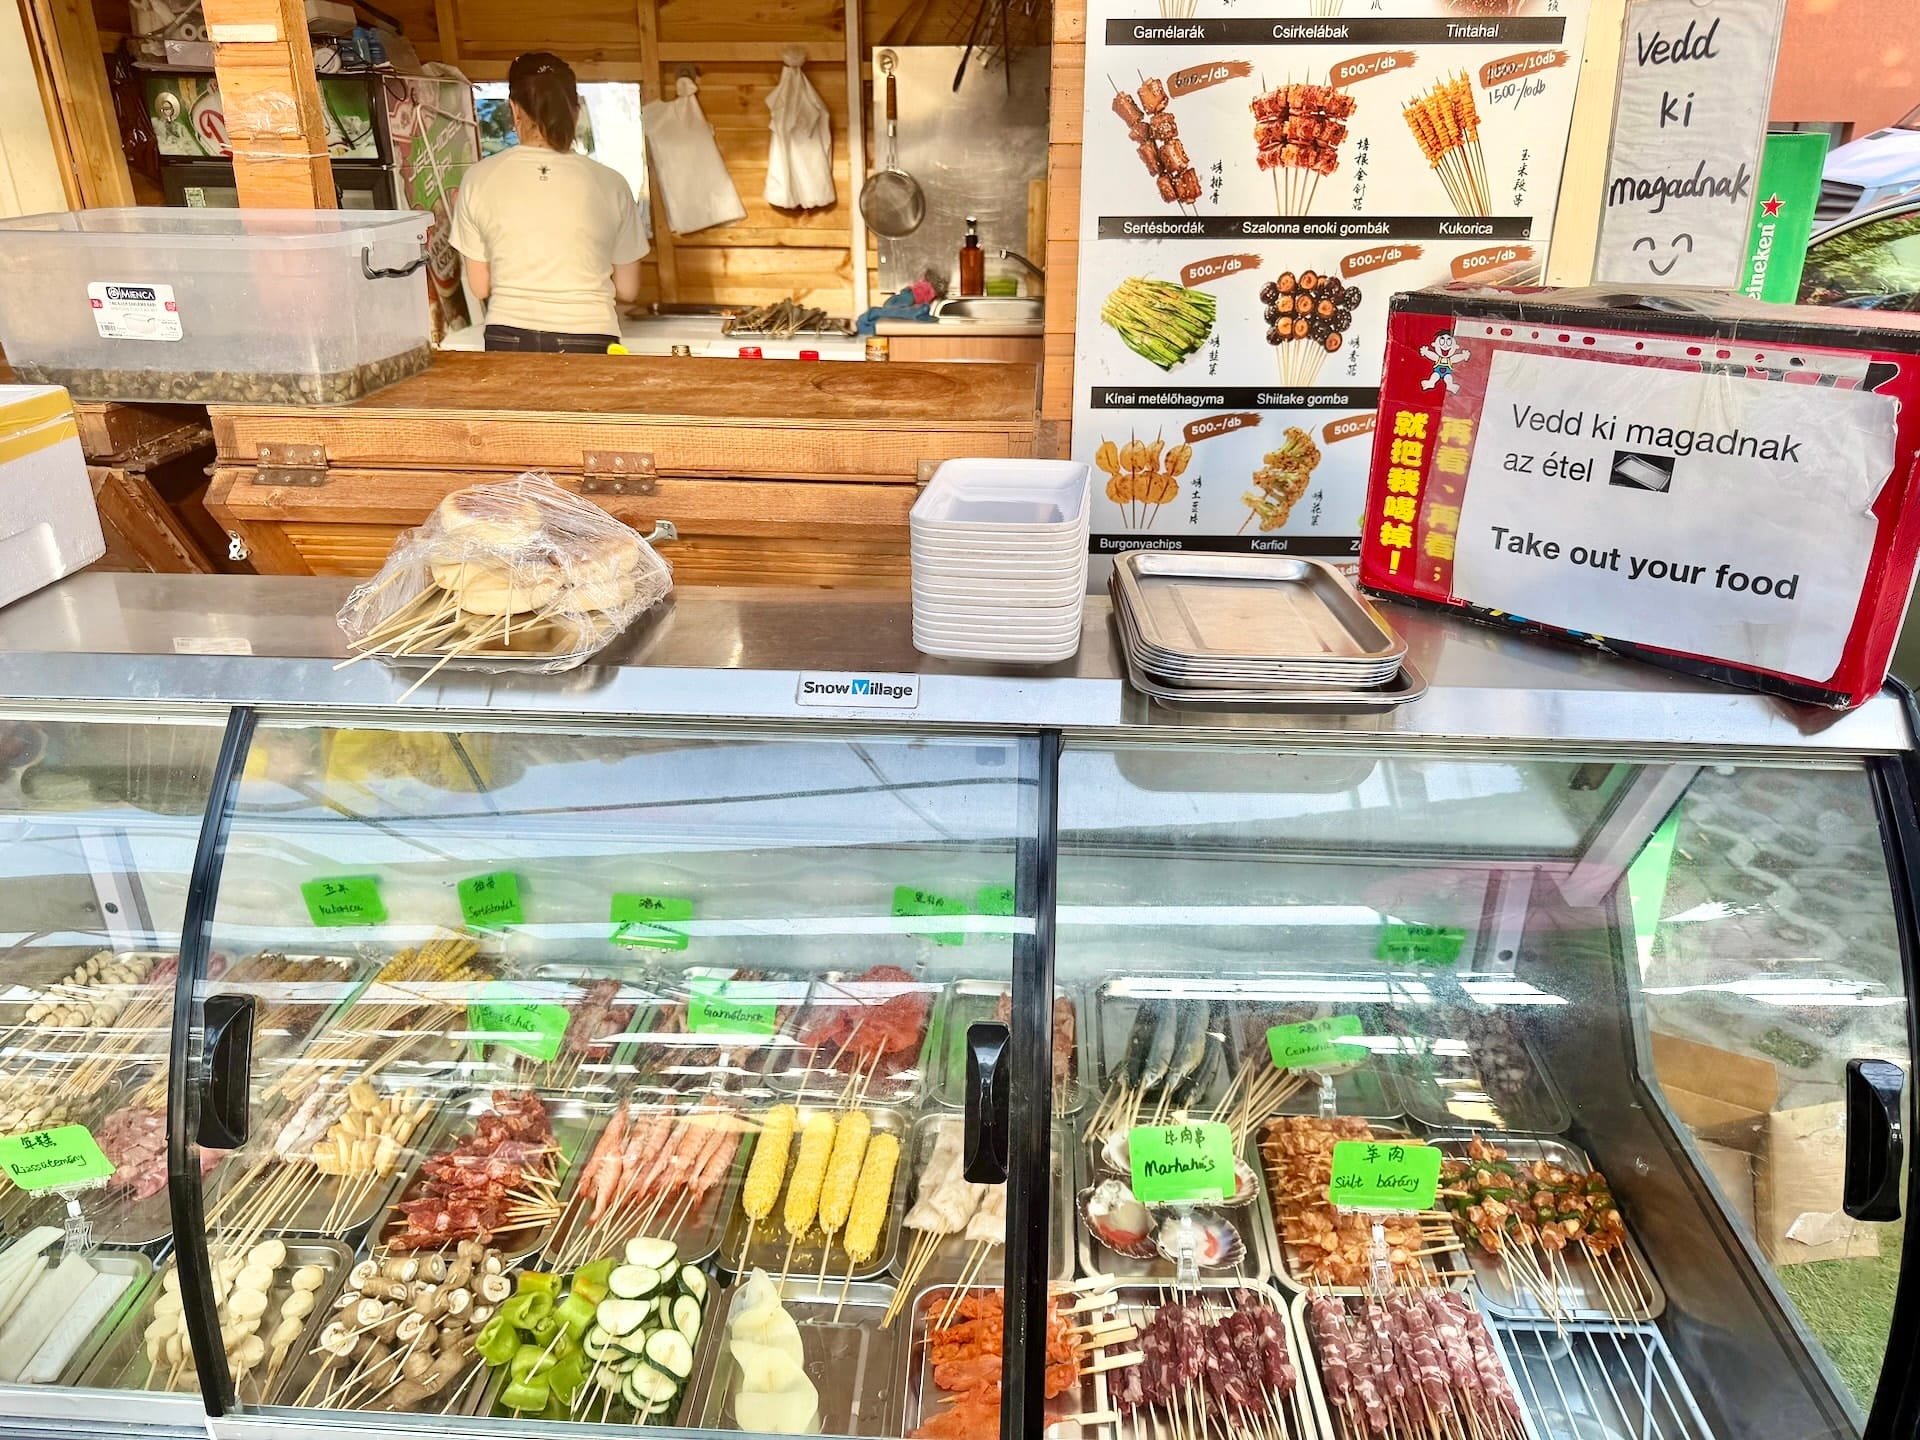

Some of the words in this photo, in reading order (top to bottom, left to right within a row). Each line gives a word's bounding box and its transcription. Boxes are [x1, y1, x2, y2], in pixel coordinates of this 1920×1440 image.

[1133, 25, 1205, 39] Garnélarák
[1272, 24, 1349, 39] Csirkelábak
[1447, 23, 1499, 38] Tintahal
[1637, 18, 1720, 67] Vedd
[1340, 56, 1397, 78] 500.-/db
[1658, 91, 1696, 129] ki
[1609, 159, 1751, 215] magadnak
[1123, 221, 1205, 236] Sertésbordák
[1242, 221, 1300, 235] Szalonna
[1303, 221, 1338, 235] enoki
[1340, 221, 1390, 239] gombák
[1438, 221, 1494, 235] Kukorica
[1348, 247, 1403, 269] 500.-/db
[1461, 248, 1517, 270] 500.-/db
[1744, 222, 1777, 301] eineken
[1188, 258, 1242, 279] 500.-/db
[1104, 392, 1135, 406] Kínai
[1137, 392, 1225, 410] metélőhagyma
[1256, 392, 1302, 406] Shiitake
[1304, 392, 1349, 410] gomba
[1190, 415, 1242, 435] 500.-/db
[1512, 403, 1584, 437] Vedd
[1591, 412, 1616, 441] ki
[1625, 420, 1803, 463] magadnak
[1503, 454, 1534, 475] az
[1541, 450, 1594, 483] étel
[1099, 538, 1183, 550] Burgonyachips
[1250, 539, 1288, 551] Karfiol
[1490, 525, 1561, 561] Take
[1569, 542, 1620, 572] out
[1627, 553, 1707, 587] your
[1714, 562, 1800, 600] food
[803, 681, 850, 695] Snow
[852, 680, 913, 699] Village
[1362, 1144, 1405, 1164] 羊肉
[1376, 1173, 1420, 1193] bárány
